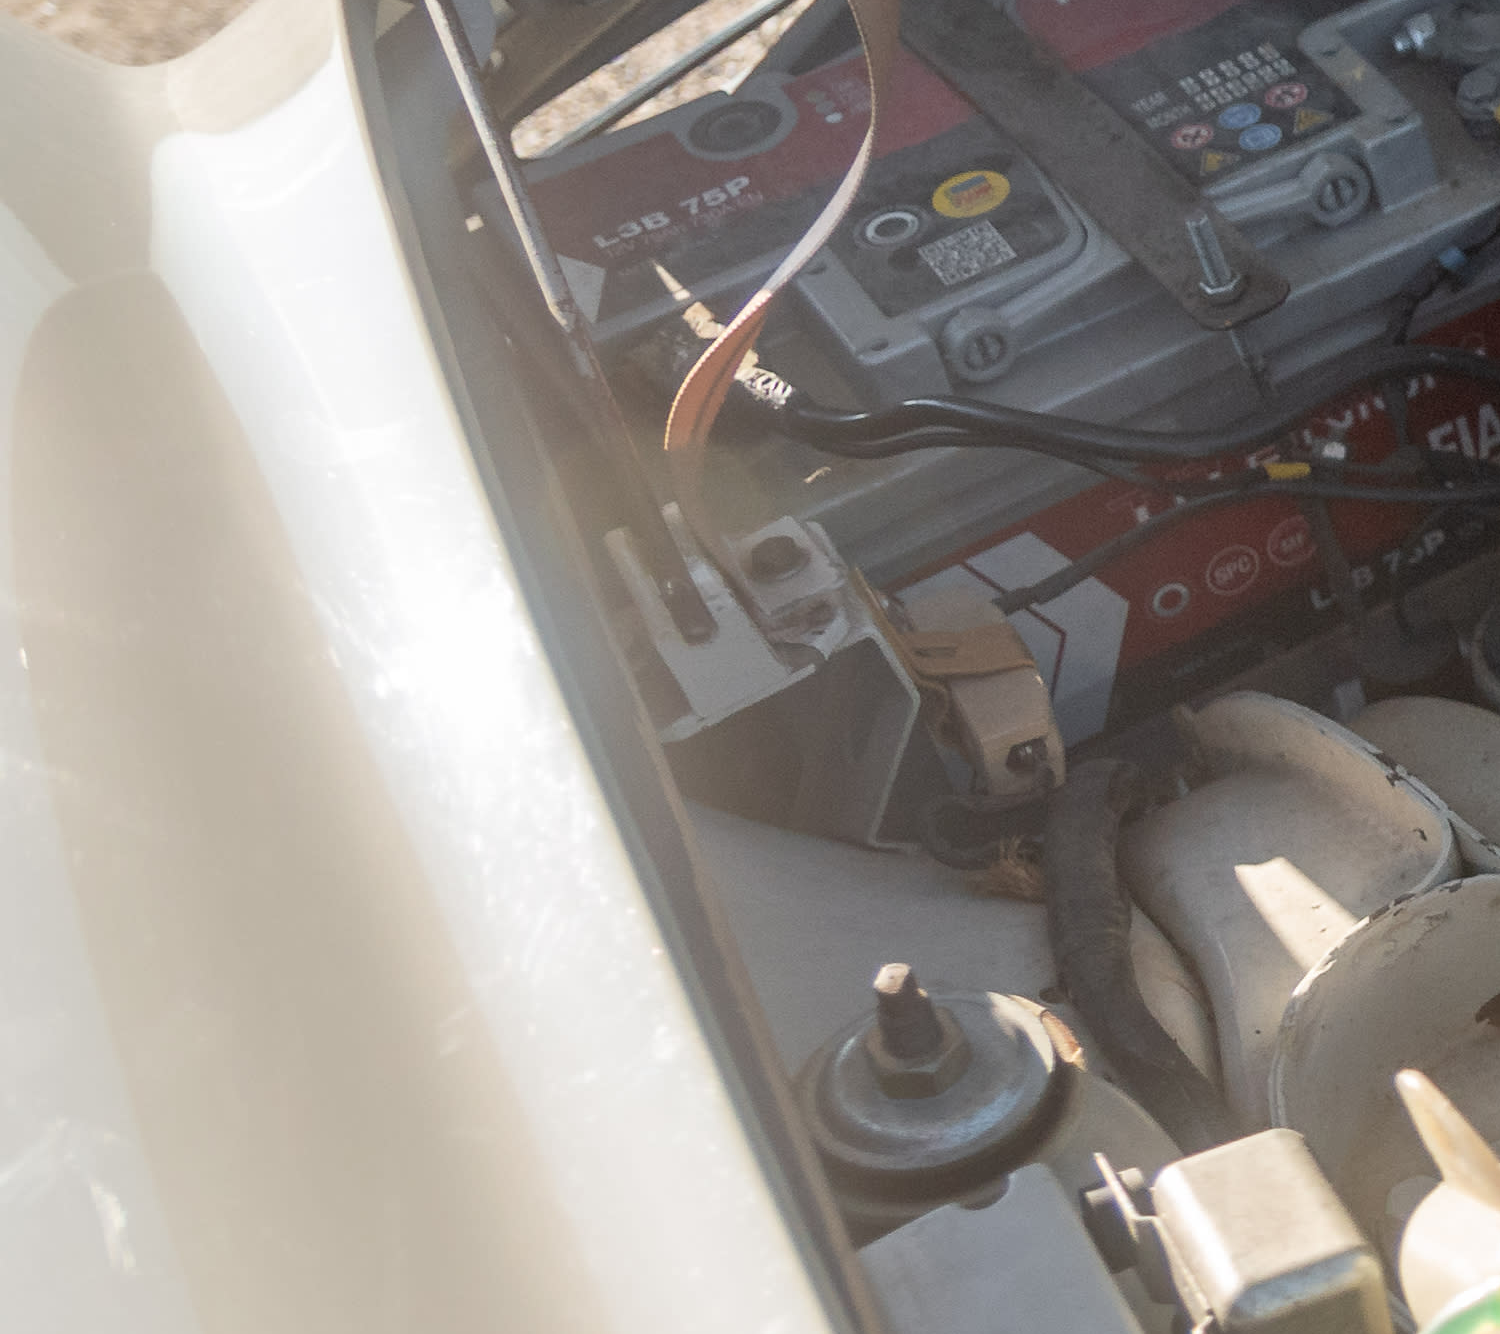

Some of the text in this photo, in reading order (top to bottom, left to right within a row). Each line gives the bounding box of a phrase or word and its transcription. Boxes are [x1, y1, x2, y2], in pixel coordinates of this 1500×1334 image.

[592, 175, 751, 249] L3B 75P
[1310, 566, 1375, 610] LB
